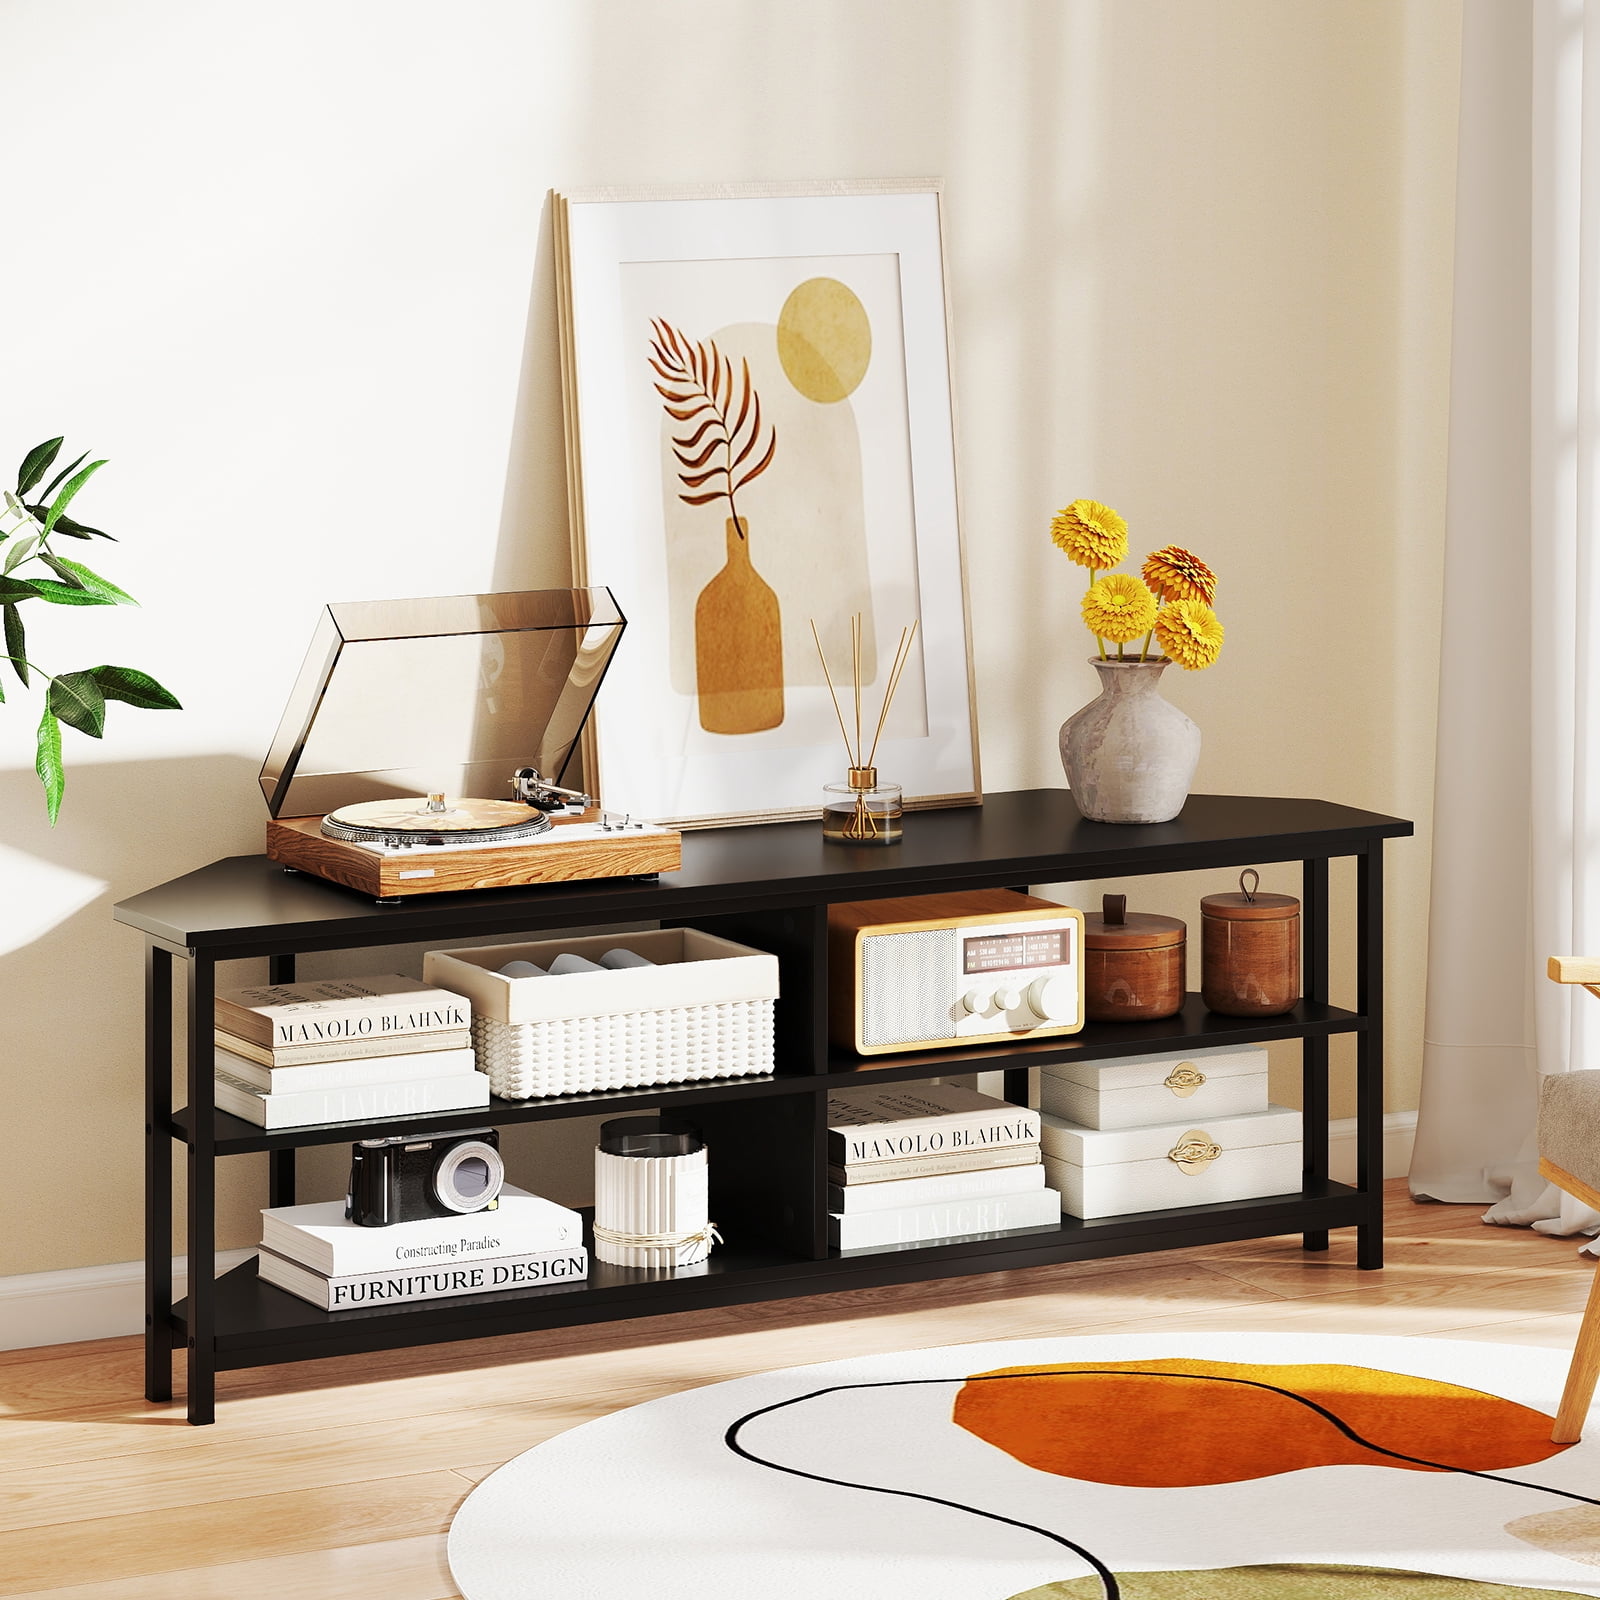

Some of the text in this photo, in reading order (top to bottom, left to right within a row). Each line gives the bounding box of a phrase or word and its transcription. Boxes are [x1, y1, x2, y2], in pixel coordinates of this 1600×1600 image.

[279, 1005, 465, 1044] MANOLO BLAHNÍK
[852, 1120, 1035, 1161] MANOLO BLAHNÍK
[395, 1236, 500, 1260] Constructing Paradies
[333, 1256, 585, 1304] FURNITURE DESIGN
